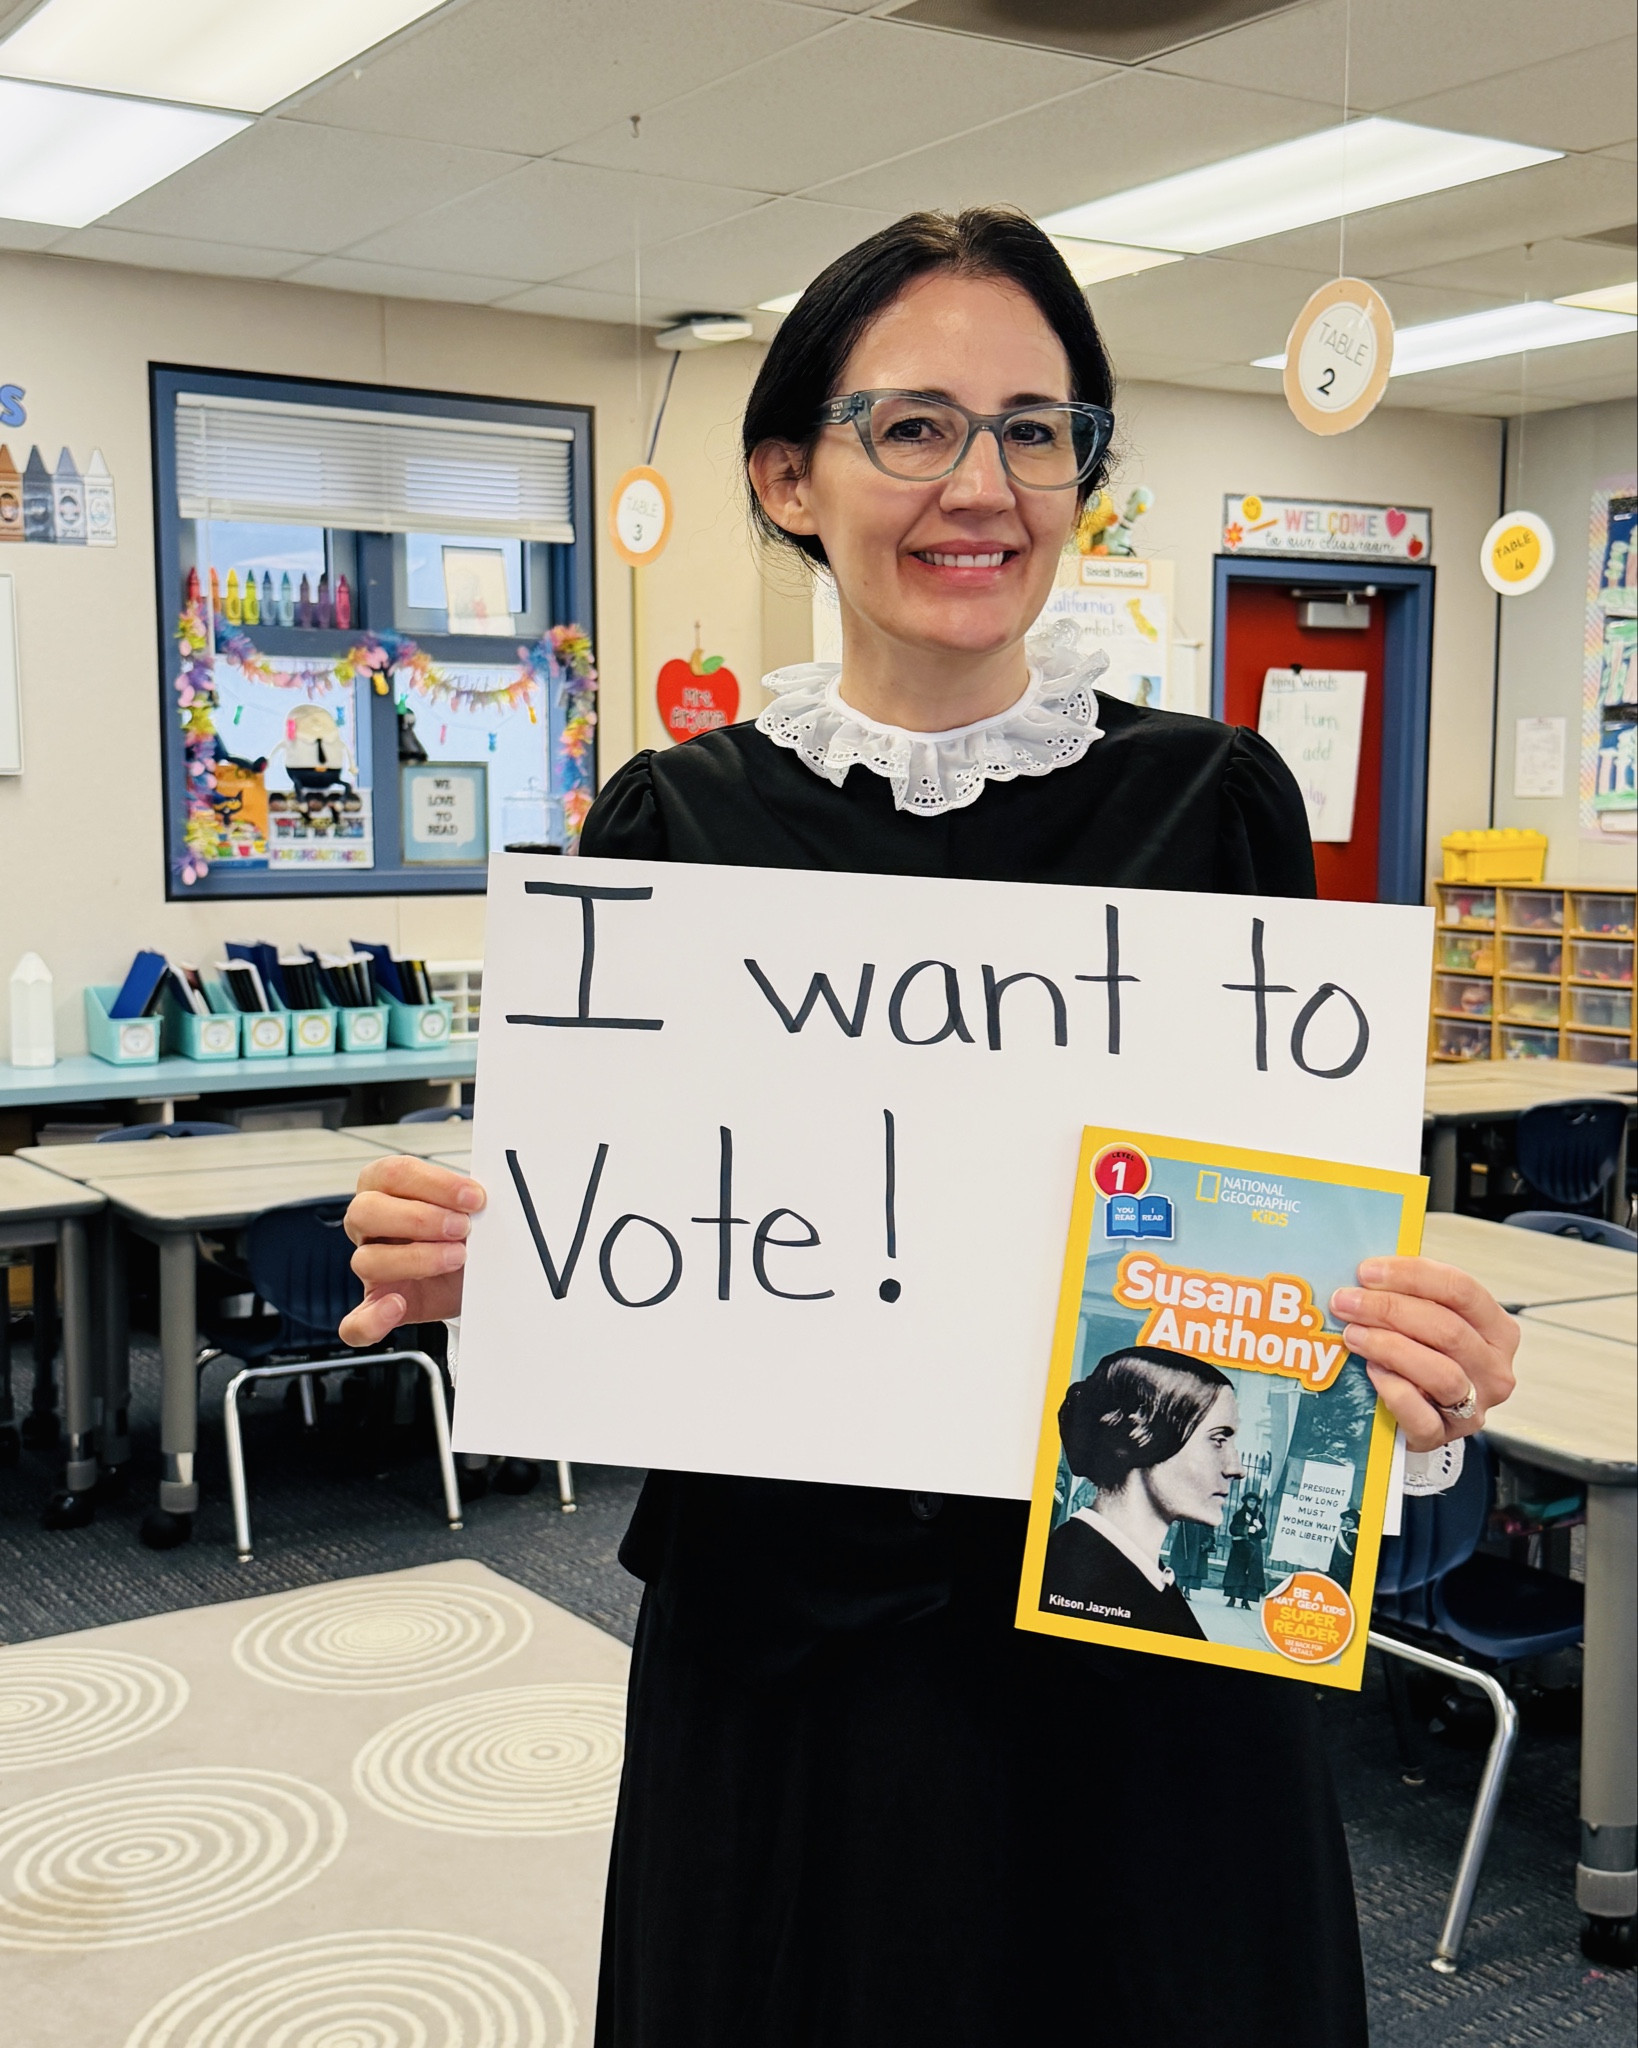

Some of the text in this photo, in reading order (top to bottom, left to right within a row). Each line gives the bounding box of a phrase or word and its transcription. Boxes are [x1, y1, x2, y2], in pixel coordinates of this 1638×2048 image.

[1318, 321, 1369, 367] TABLE
[1317, 367, 1336, 396] 2
[624, 496, 658, 518] TABLE
[632, 523, 643, 541] 3
[1284, 509, 1378, 537] WELCOME
[1265, 531, 1281, 548] to
[1287, 534, 1316, 549] our
[1494, 530, 1532, 559] TABLE
[1515, 558, 1524, 571] 4
[434, 779, 450, 790] WE
[427, 795, 456, 807] LOVE
[435, 812, 452, 823] TO
[427, 824, 459, 836] READ
[506, 880, 1370, 1078] I want to
[1111, 1151, 1135, 1162] LEVEL
[1111, 1161, 1127, 1191] 1
[1223, 1176, 1285, 1197] NATIONAL
[506, 1109, 902, 1307] Vote!
[1116, 1206, 1135, 1214] YOU
[1220, 1189, 1301, 1213] GEOGRAPHIC
[1114, 1213, 1136, 1221] READ
[1141, 1214, 1164, 1222] READ
[1123, 1260, 1314, 1328] Susan B.
[1147, 1308, 1342, 1382] Anthony
[1302, 1482, 1347, 1497] PRESIDENT
[1292, 1494, 1339, 1508] HOW LONG
[1298, 1506, 1326, 1518] MUST
[1283, 1515, 1338, 1532] WOMEN WAIT
[1280, 1526, 1335, 1545] FOR LIBERTY
[1292, 1586, 1325, 1603] BE A
[1048, 1593, 1132, 1619] Kitson Jazynka
[1272, 1596, 1347, 1617] NAT GEO KIDS
[1279, 1606, 1337, 1629] SUPER
[1272, 1618, 1340, 1644] READER
